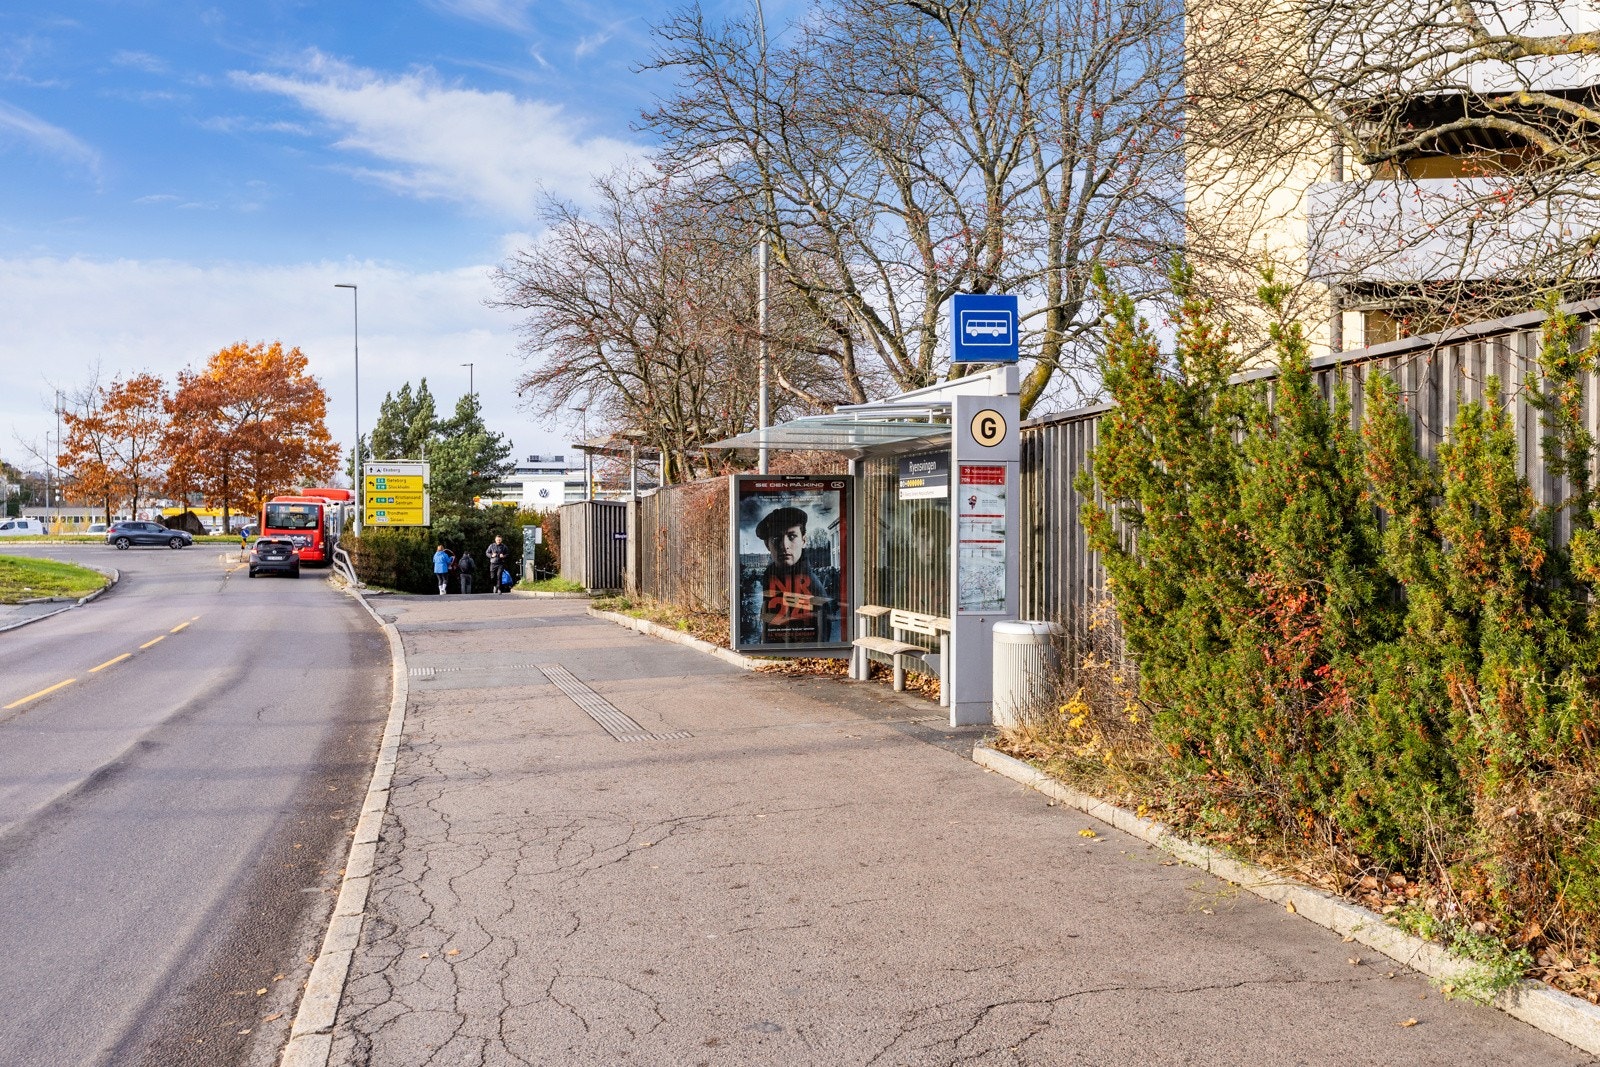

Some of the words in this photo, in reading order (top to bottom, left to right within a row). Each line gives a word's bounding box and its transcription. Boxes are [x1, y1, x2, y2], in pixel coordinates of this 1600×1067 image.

[981, 417, 996, 439] G
[909, 459, 936, 475] Ryensvingen
[769, 575, 812, 598] NR
